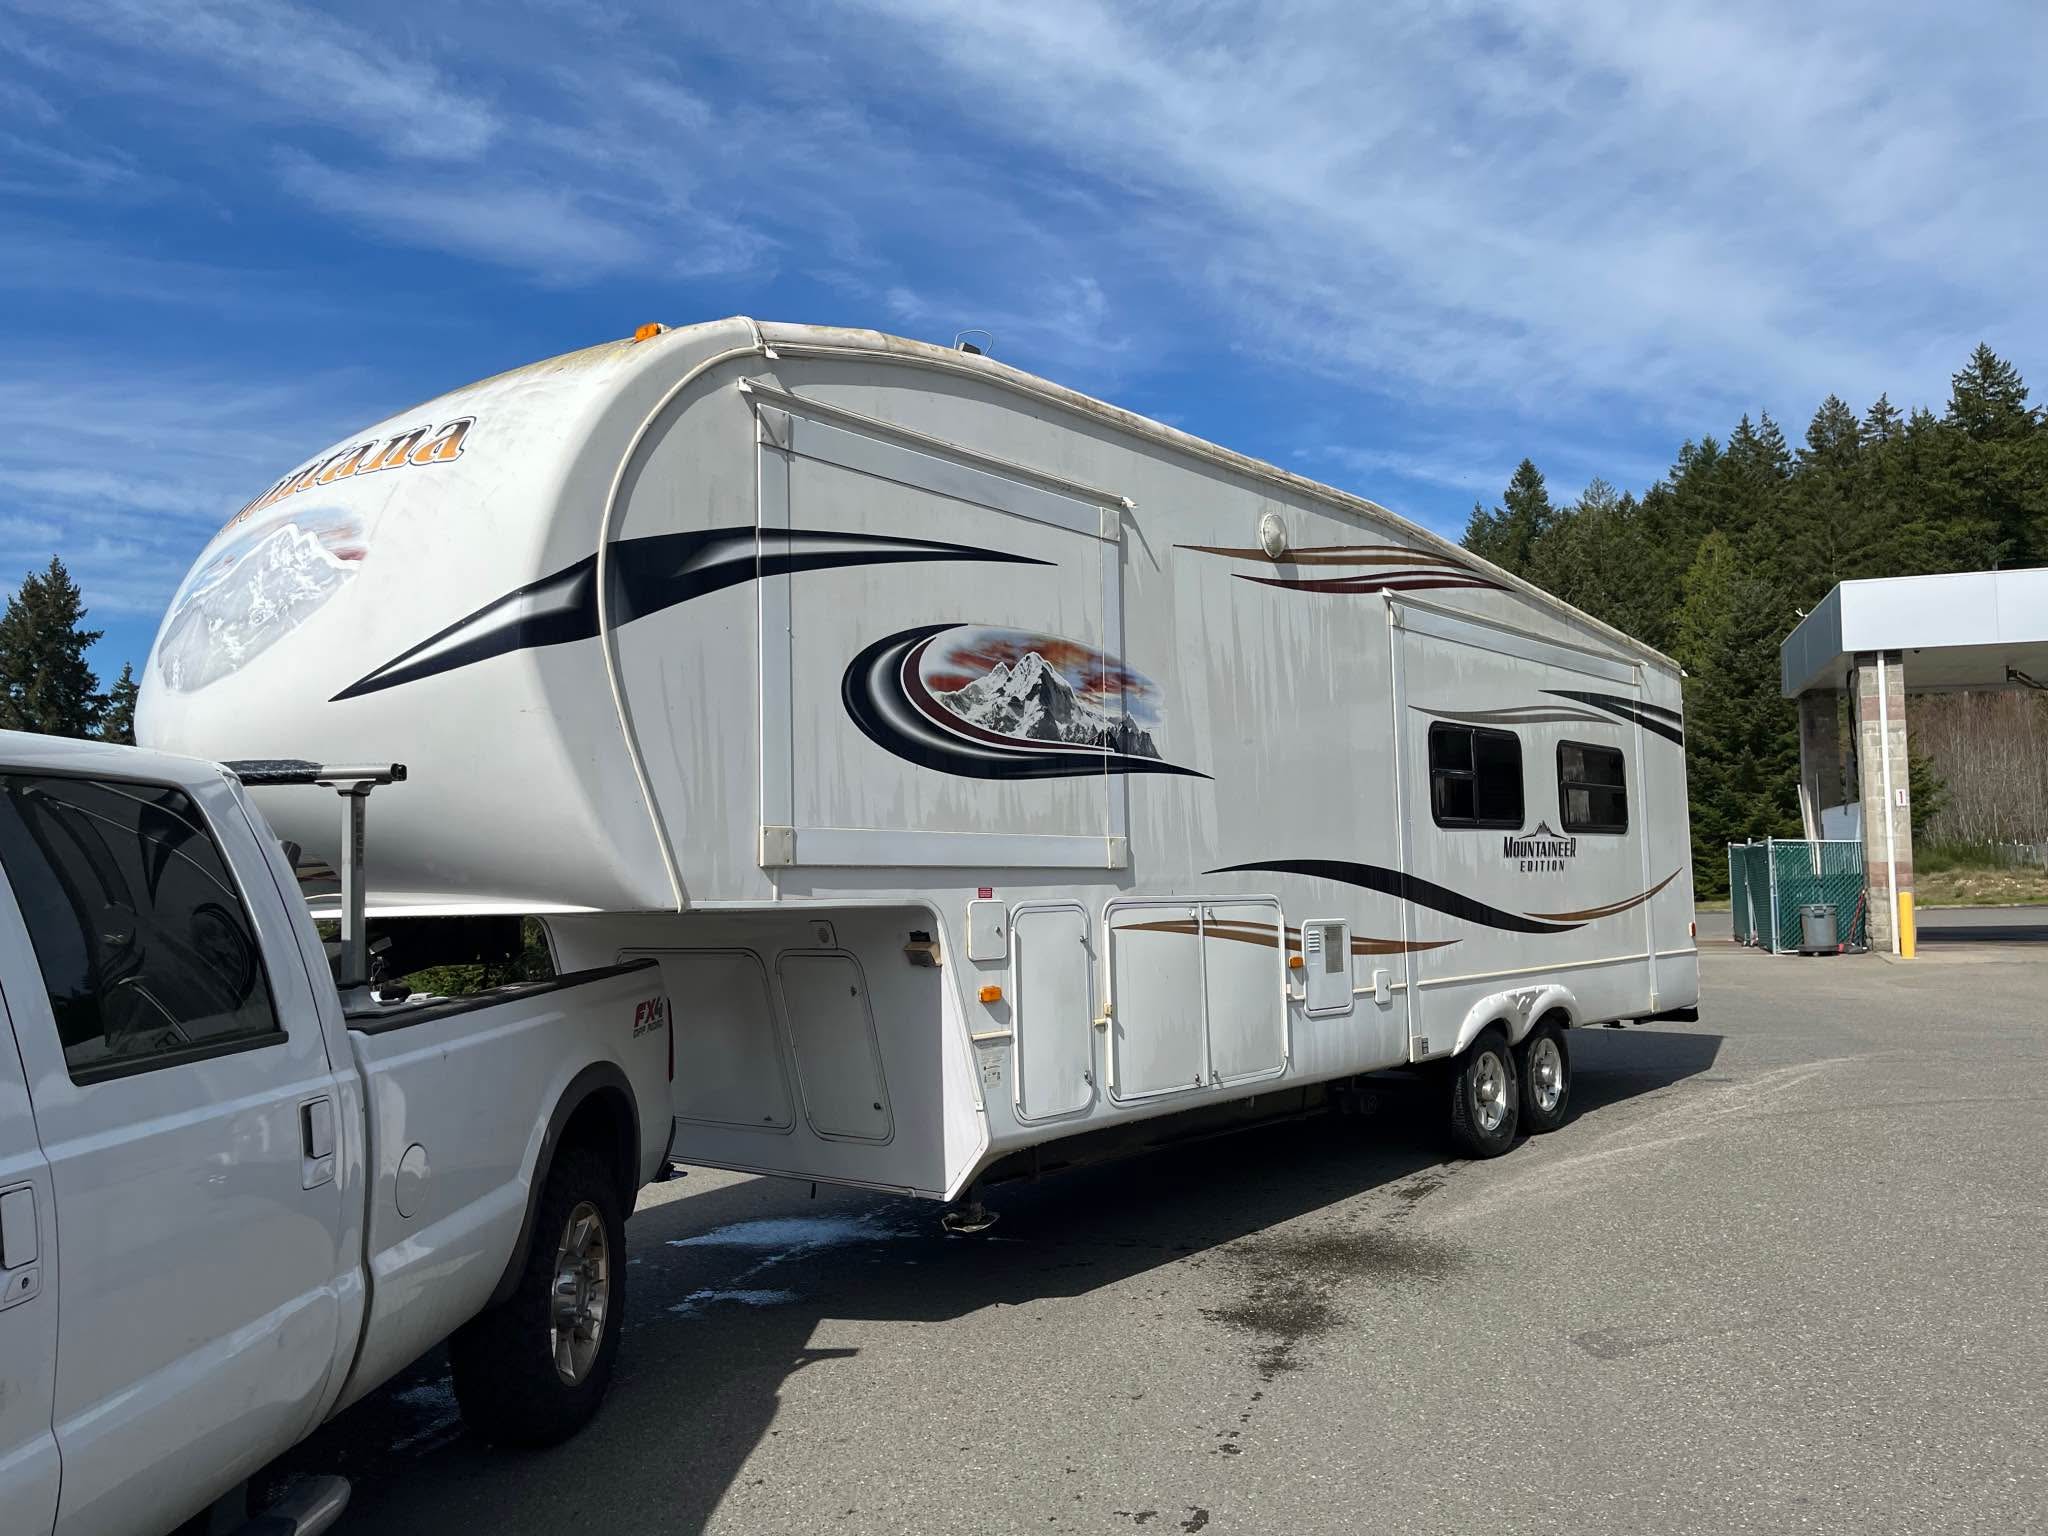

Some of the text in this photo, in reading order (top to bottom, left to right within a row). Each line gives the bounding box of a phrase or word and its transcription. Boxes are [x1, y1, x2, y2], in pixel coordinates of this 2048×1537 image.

[219, 416, 477, 534] ontana
[1503, 836, 1576, 858] MOUNTAINEER
[1520, 860, 1565, 872] EDITION
[634, 996, 663, 1028] FX4
